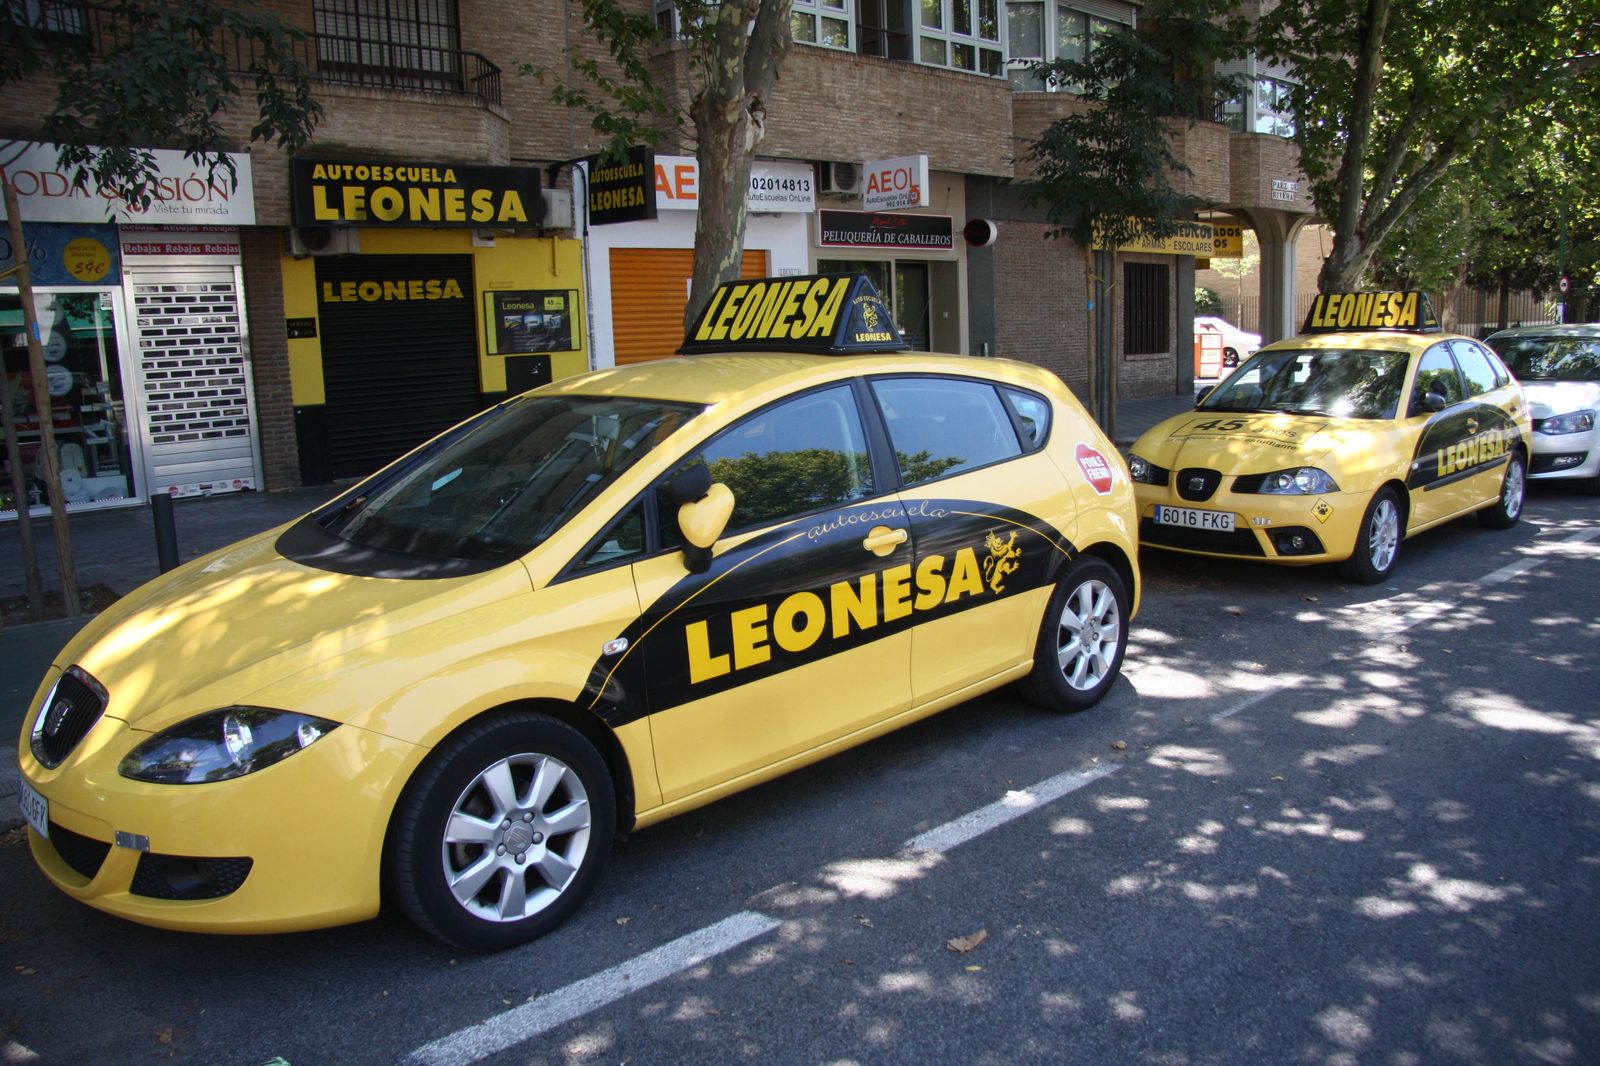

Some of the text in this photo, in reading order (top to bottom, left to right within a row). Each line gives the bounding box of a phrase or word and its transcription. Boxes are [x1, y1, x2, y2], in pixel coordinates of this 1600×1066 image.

[0, 167, 91, 198] ODA
[312, 164, 457, 183] AUTOESCUELA
[590, 162, 644, 184] AUTOESCUELA
[749, 177, 810, 192] 02014813
[312, 185, 528, 222] LEONESA
[590, 186, 645, 211] LEONESA
[749, 192, 788, 202] utoEscuelas
[153, 203, 229, 215] Viste tu mirada
[823, 229, 951, 245] PELUQUERÍA DE CABALLEROS
[1173, 241, 1212, 252] ESCOLARES
[124, 244, 239, 254] Rebajas Rebajas Rebajas
[323, 279, 464, 303] LEONESA
[502, 302, 535, 310] Leonesa
[694, 277, 851, 341] LEONESA
[1311, 291, 1418, 328] LEONESA
[855, 332, 891, 342] LEONESA
[1193, 419, 1248, 431] 45
[1437, 430, 1504, 477] LEONESA
[807, 501, 948, 540] autoescuela
[1163, 508, 1229, 529] 6016 FKG
[685, 548, 984, 684] LEONESA
